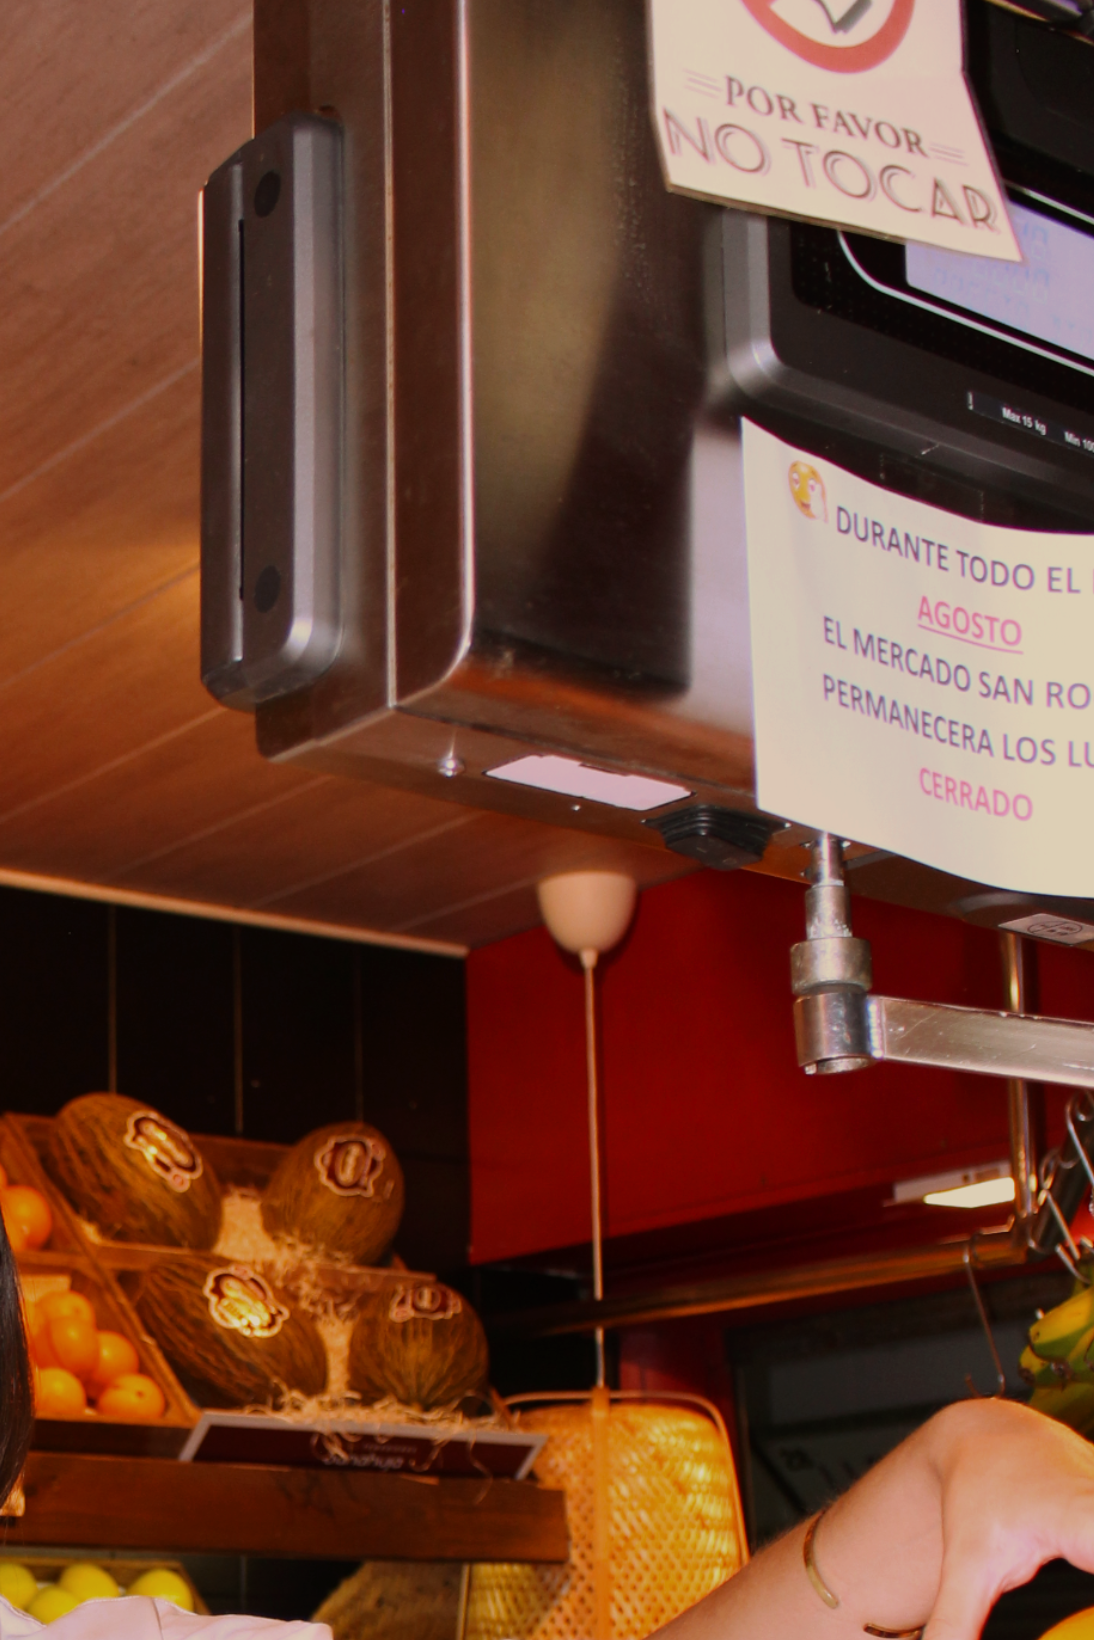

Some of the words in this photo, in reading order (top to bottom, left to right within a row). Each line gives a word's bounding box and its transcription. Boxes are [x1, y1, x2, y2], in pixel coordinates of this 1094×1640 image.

[724, 75, 805, 124] POR
[810, 102, 930, 159] FAVOR
[662, 107, 770, 176] NO
[780, 136, 1004, 235] TOCAR
[836, 505, 950, 573] DURANTE
[955, 549, 1036, 591] TODO
[1046, 565, 1082, 594] EL
[823, 615, 848, 651] EL
[852, 627, 972, 692] MERCADO
[978, 670, 1034, 706] SAN
[1045, 680, 1092, 710] RO
[917, 595, 1024, 648] AGOSTO
[823, 673, 995, 758] PERMANECERA
[1002, 733, 1057, 766] LOS
[918, 767, 1034, 822] CERRADO
